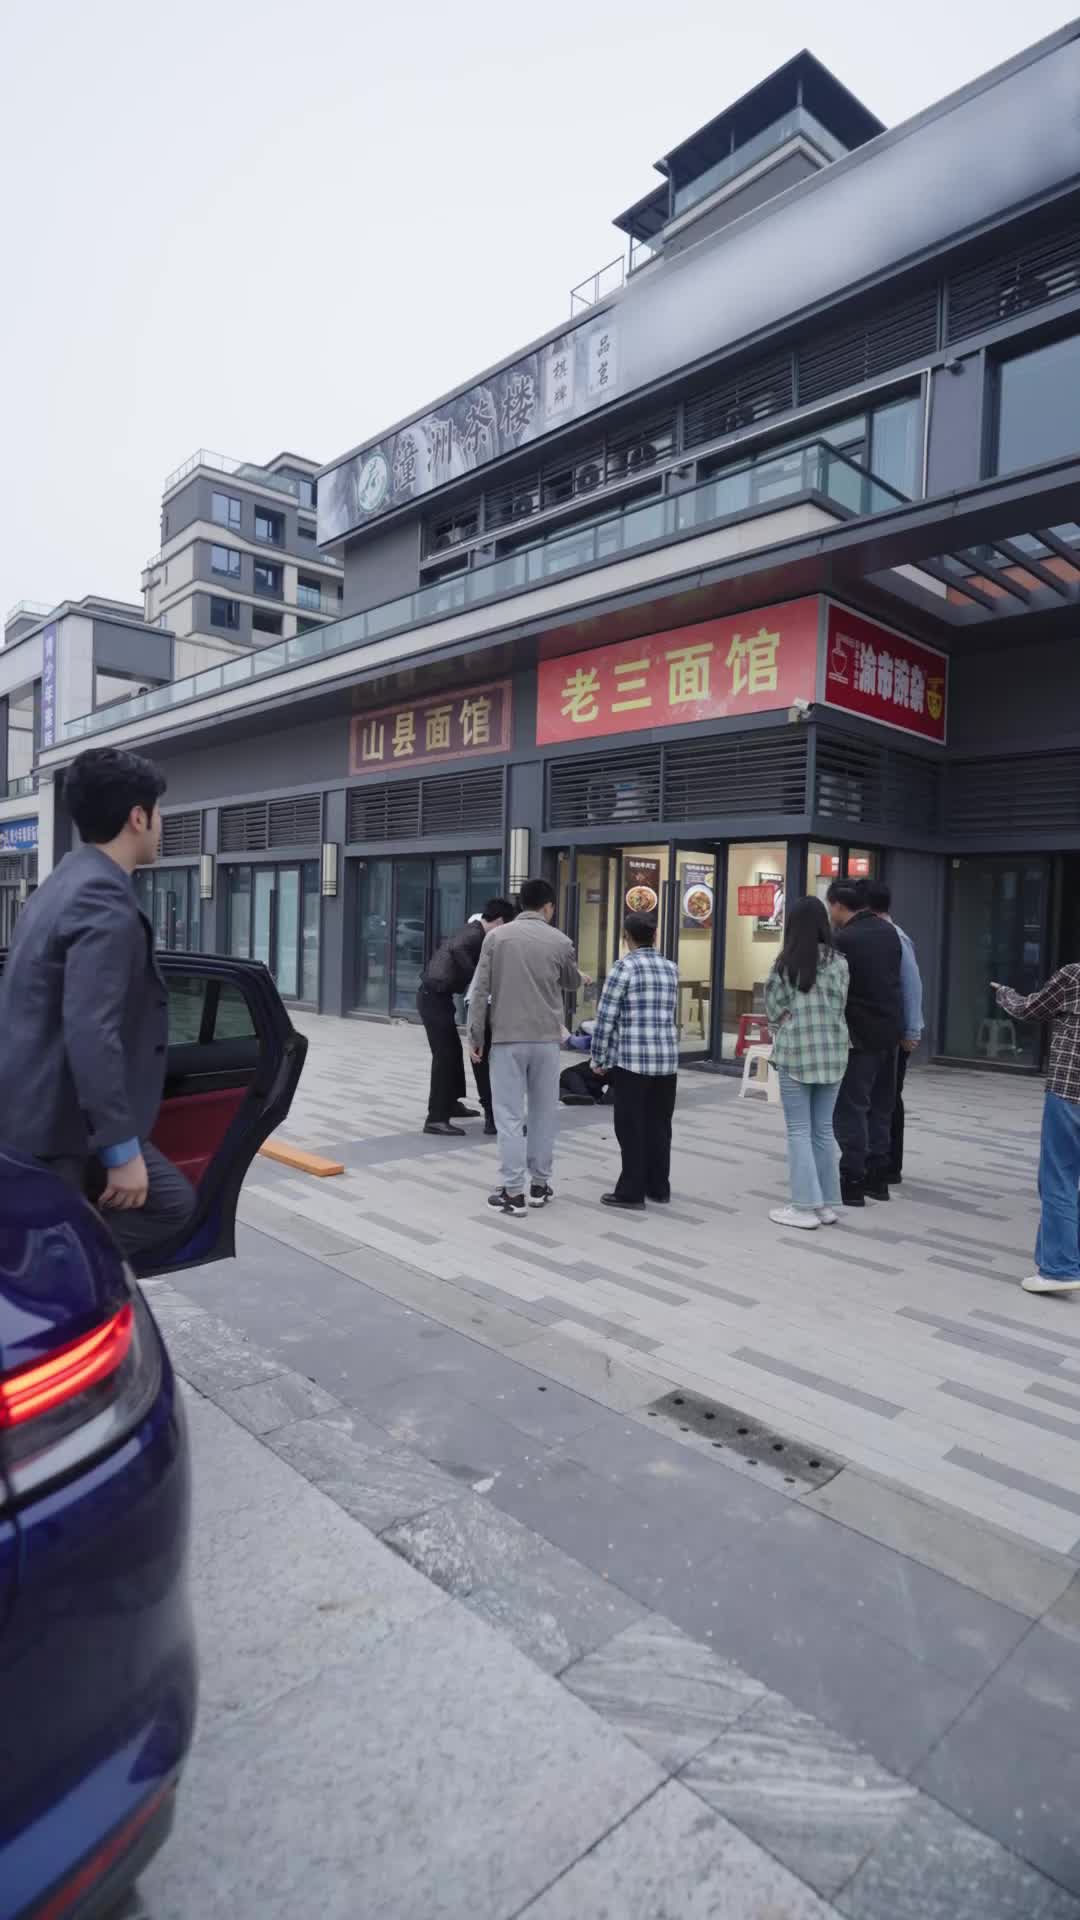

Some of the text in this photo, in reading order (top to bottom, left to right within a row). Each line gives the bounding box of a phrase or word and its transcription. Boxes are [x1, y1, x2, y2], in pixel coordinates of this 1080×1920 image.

[561, 627, 780, 724] 老三面馆
[362, 696, 491, 761] 山县面馆
